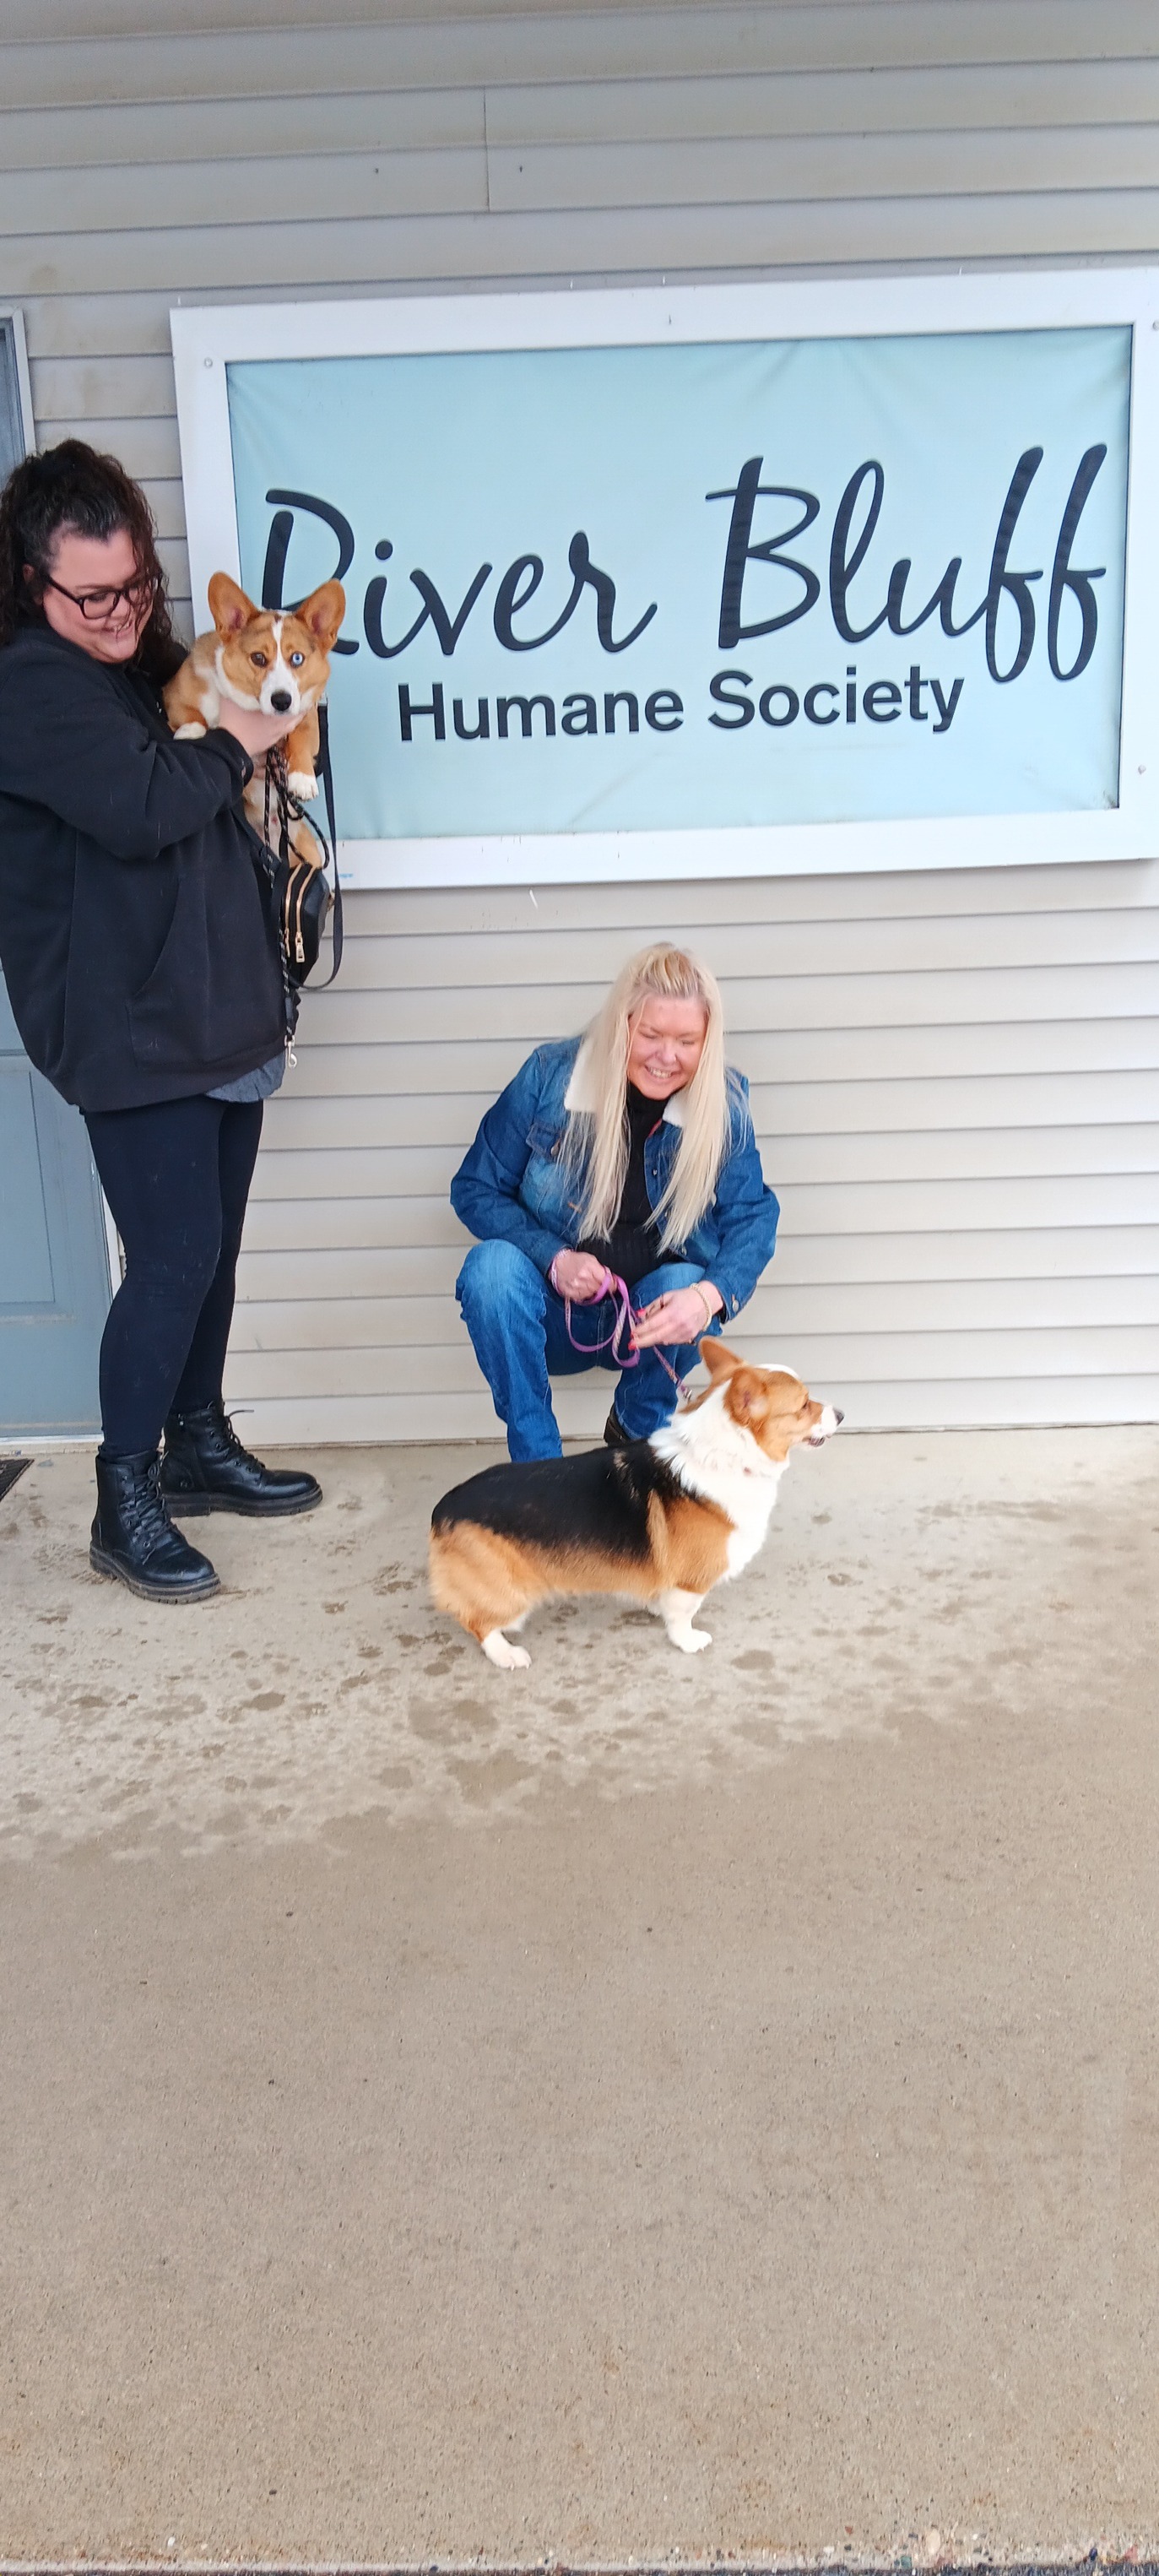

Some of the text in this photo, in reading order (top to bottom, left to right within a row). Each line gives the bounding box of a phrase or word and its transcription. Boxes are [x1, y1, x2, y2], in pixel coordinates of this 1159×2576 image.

[261, 442, 1108, 684] River Bluff
[398, 664, 965, 742] Humane Society
